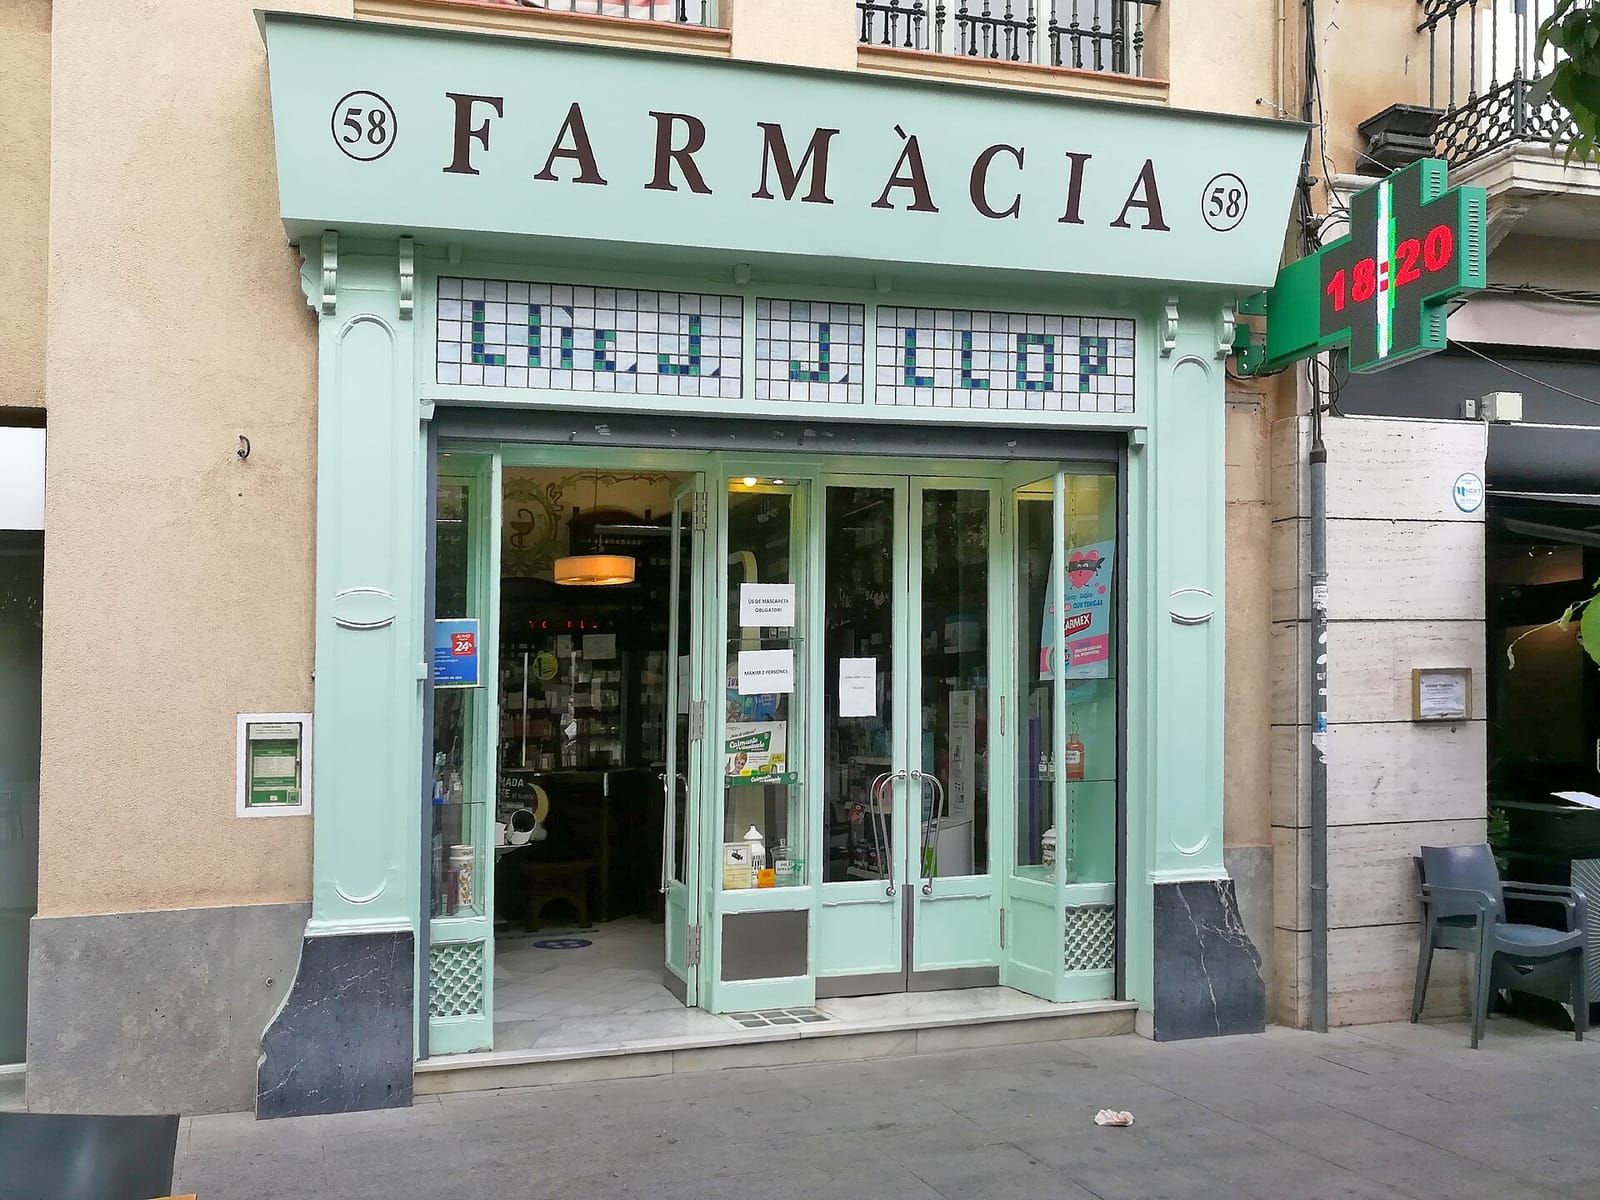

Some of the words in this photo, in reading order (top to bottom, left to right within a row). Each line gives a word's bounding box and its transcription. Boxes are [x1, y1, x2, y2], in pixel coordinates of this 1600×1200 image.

[343, 107, 387, 145] 58
[442, 91, 1171, 232] FARMÀCIA
[1208, 188, 1241, 219] 58
[1326, 224, 1453, 312] 18:20
[904, 326, 1109, 393] LLOP
[729, 737, 758, 749] Calmante
